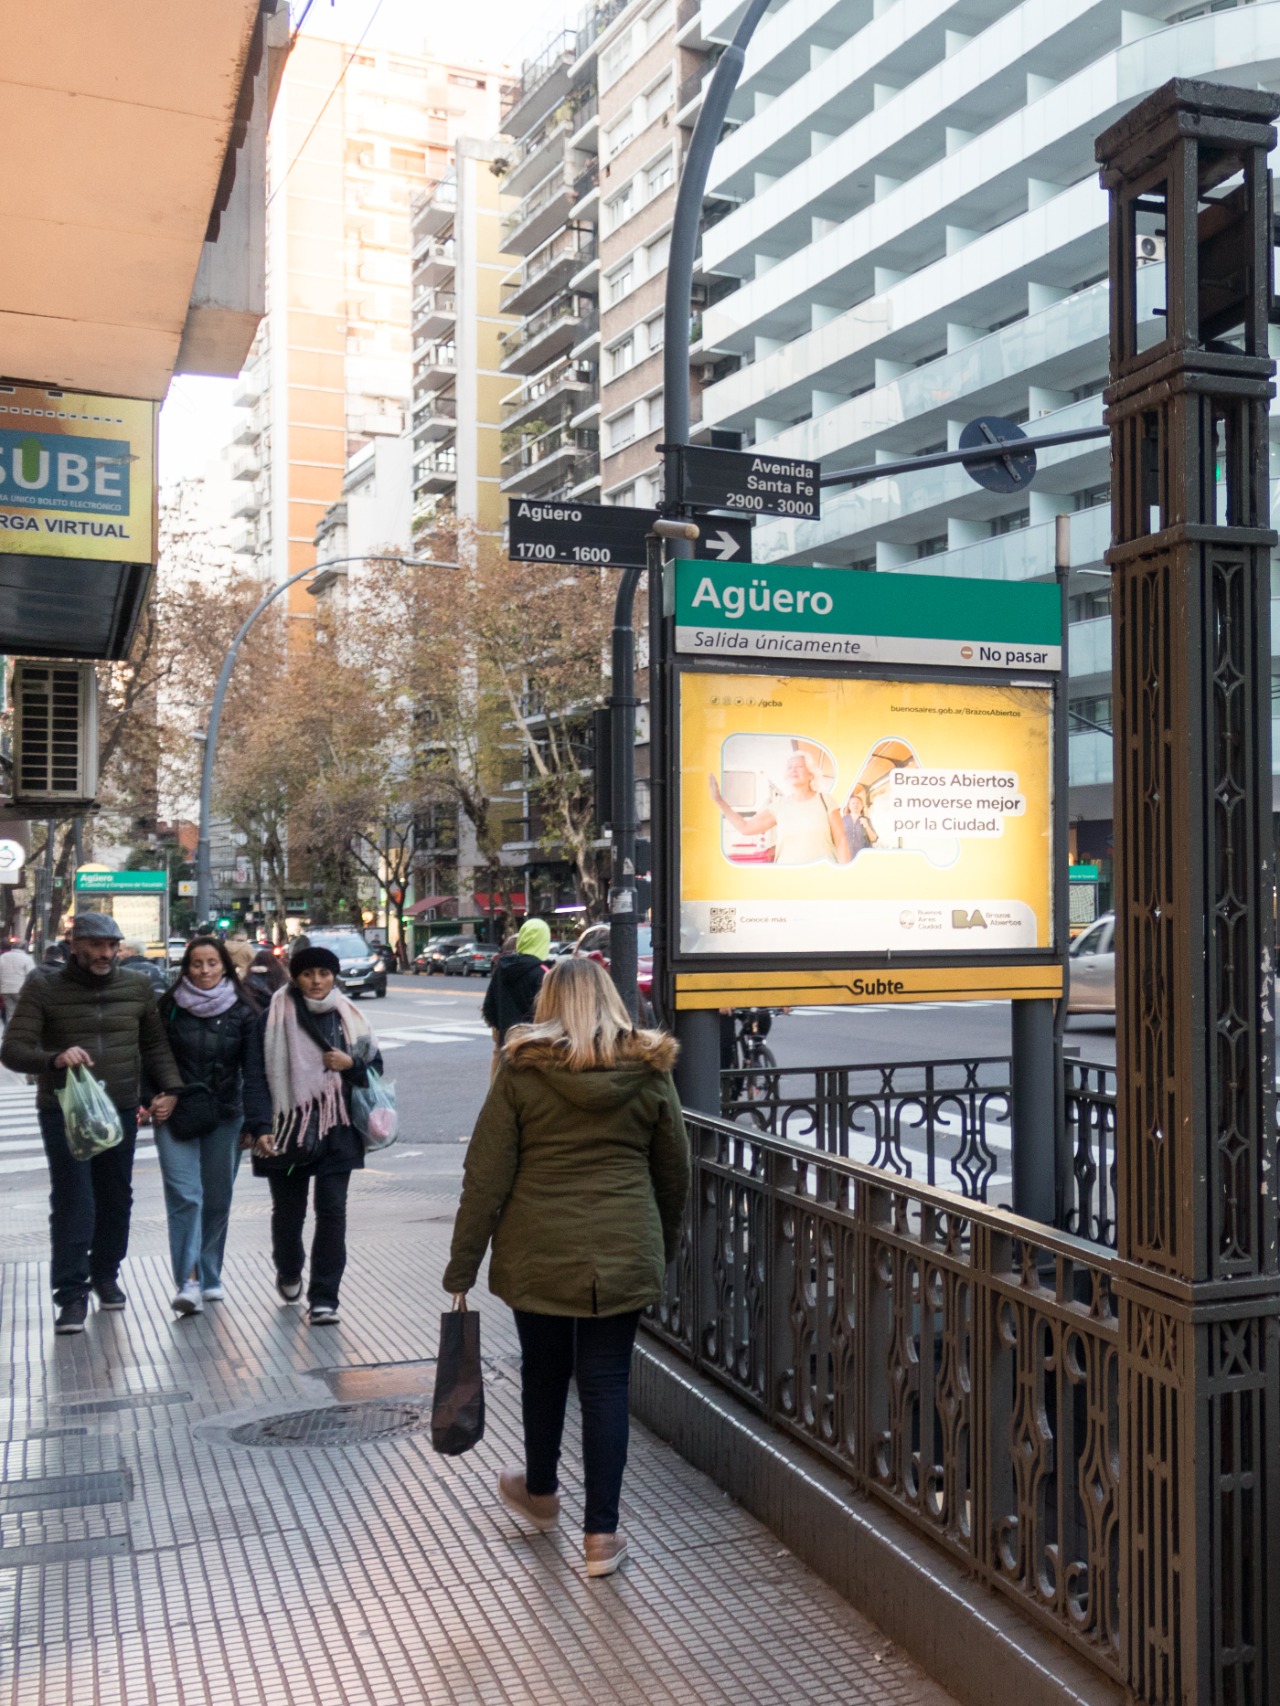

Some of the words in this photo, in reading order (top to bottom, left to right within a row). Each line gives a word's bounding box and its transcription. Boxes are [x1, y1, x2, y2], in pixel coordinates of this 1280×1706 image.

[0, 447, 122, 497] UBE
[750, 458, 814, 478] Avenida
[747, 476, 792, 494] Santa
[795, 480, 814, 497] Fe
[37, 497, 68, 507] BOLETO
[517, 502, 582, 522] Agüero
[726, 493, 763, 510] 2900
[777, 499, 814, 516] 3000
[44, 518, 130, 539] VIRTUAL
[516, 543, 556, 559] 1700
[572, 546, 611, 563] 1600
[691, 577, 833, 618] Agüero
[694, 631, 749, 650] Salida
[755, 635, 861, 654] únicamente
[979, 646, 1002, 662] No
[1006, 649, 1048, 665] pasar
[894, 772, 946, 786] Brazos
[950, 773, 1015, 788] Abiertos
[893, 797, 903, 808] a
[907, 798, 973, 809] moverse
[976, 795, 1021, 812] mejor
[894, 819, 921, 832] por
[925, 817, 937, 830] la
[942, 817, 999, 831] Ciudad.
[851, 978, 904, 996] Subte
